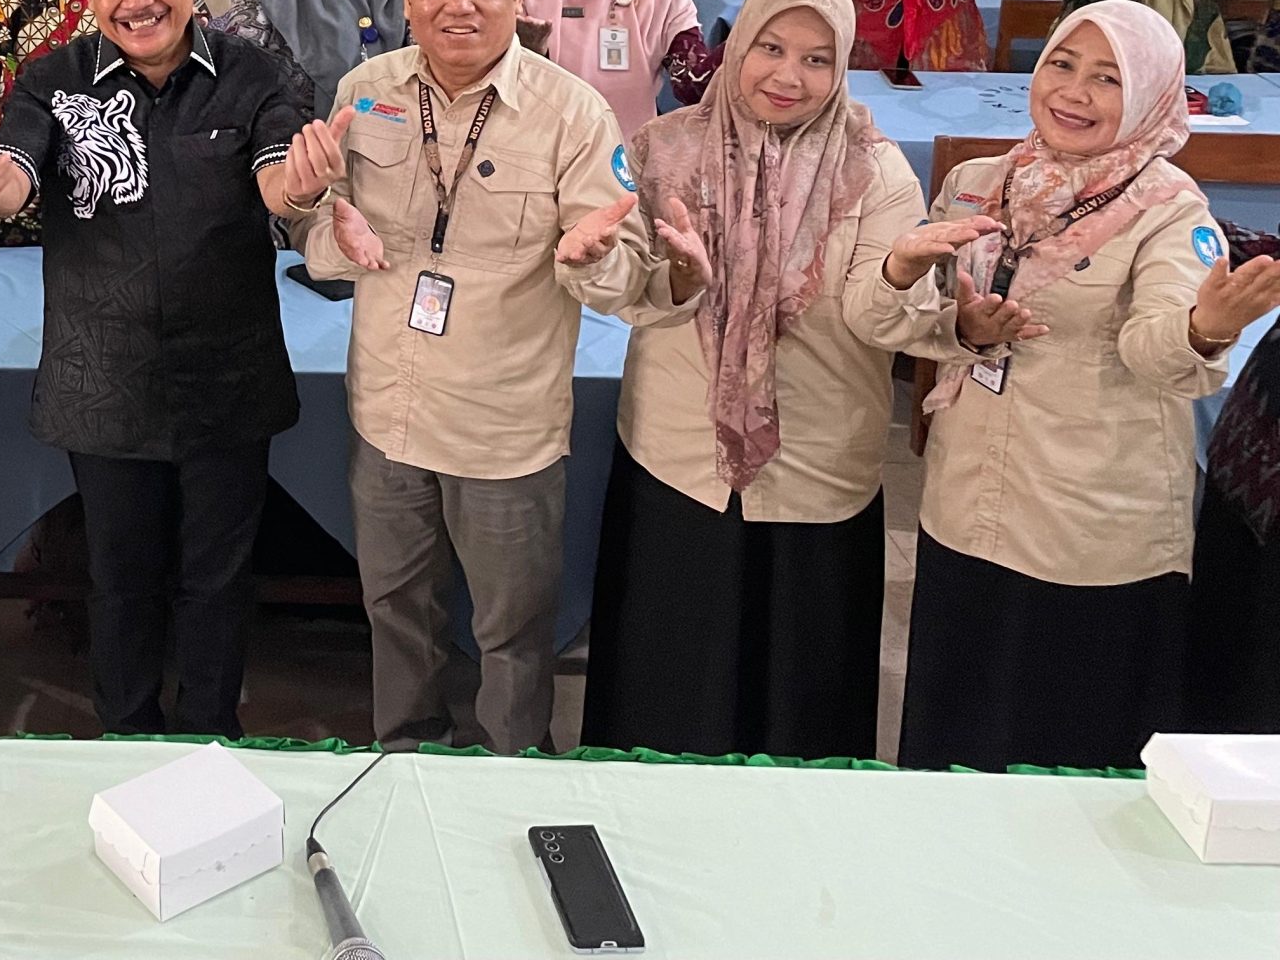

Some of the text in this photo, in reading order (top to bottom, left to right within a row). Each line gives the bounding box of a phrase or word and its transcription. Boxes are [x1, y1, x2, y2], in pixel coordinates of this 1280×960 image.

[420, 83, 433, 134] ASILITATOR
[470, 94, 493, 140] SILITATOR
[1069, 187, 1119, 219] SILITATOR
